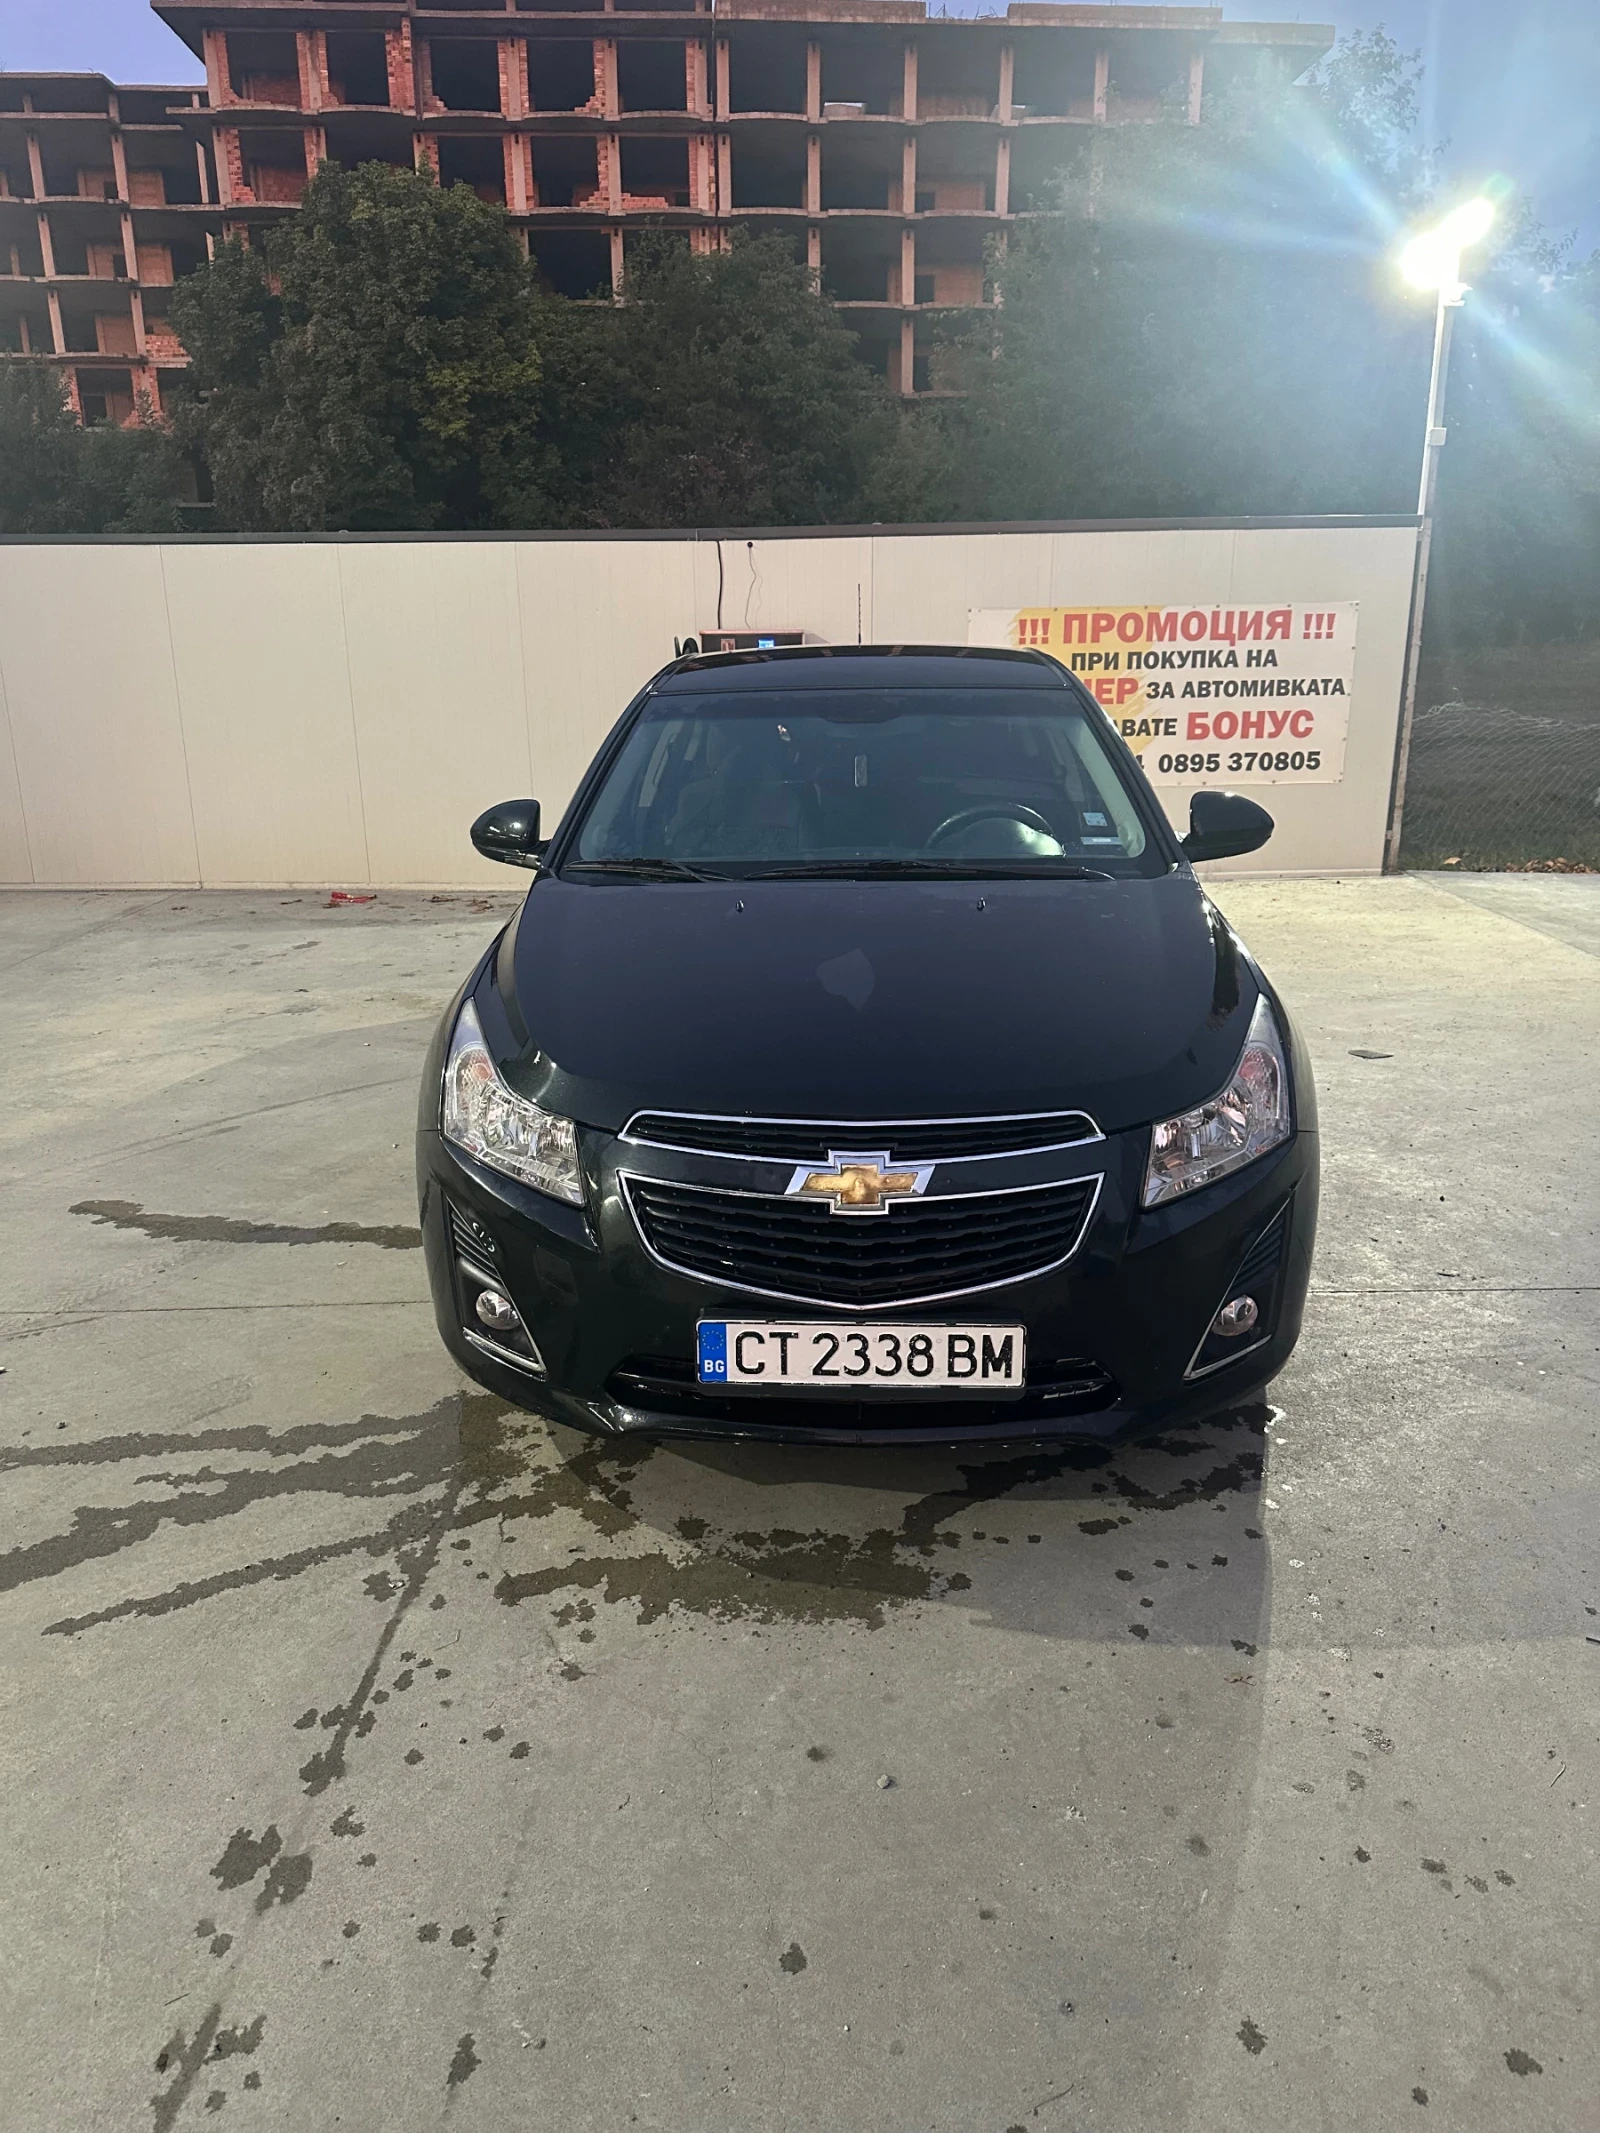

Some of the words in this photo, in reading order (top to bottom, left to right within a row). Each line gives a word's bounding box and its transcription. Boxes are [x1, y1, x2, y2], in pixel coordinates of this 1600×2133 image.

[1018, 618, 1050, 645] !!!
[1062, 609, 1293, 647] ПРОМОЦИЯ
[1303, 612, 1337, 640] !!!
[1071, 651, 1120, 671] ПРИ
[1126, 649, 1239, 670] ПОКУПКА
[1246, 648, 1278, 668] НА
[1145, 681, 1175, 699] ЗА
[1180, 678, 1346, 699] АВТОМИВКАТА
[1113, 718, 1178, 737] ВАТЕ
[1186, 709, 1315, 741] БОНУС
[1158, 753, 1220, 774] 0895
[1227, 750, 1321, 772] 370805
[704, 1359, 725, 1374] BG
[734, 1330, 799, 1376] CT
[811, 1332, 935, 1378] 2338
[947, 1333, 1014, 1379] BM
